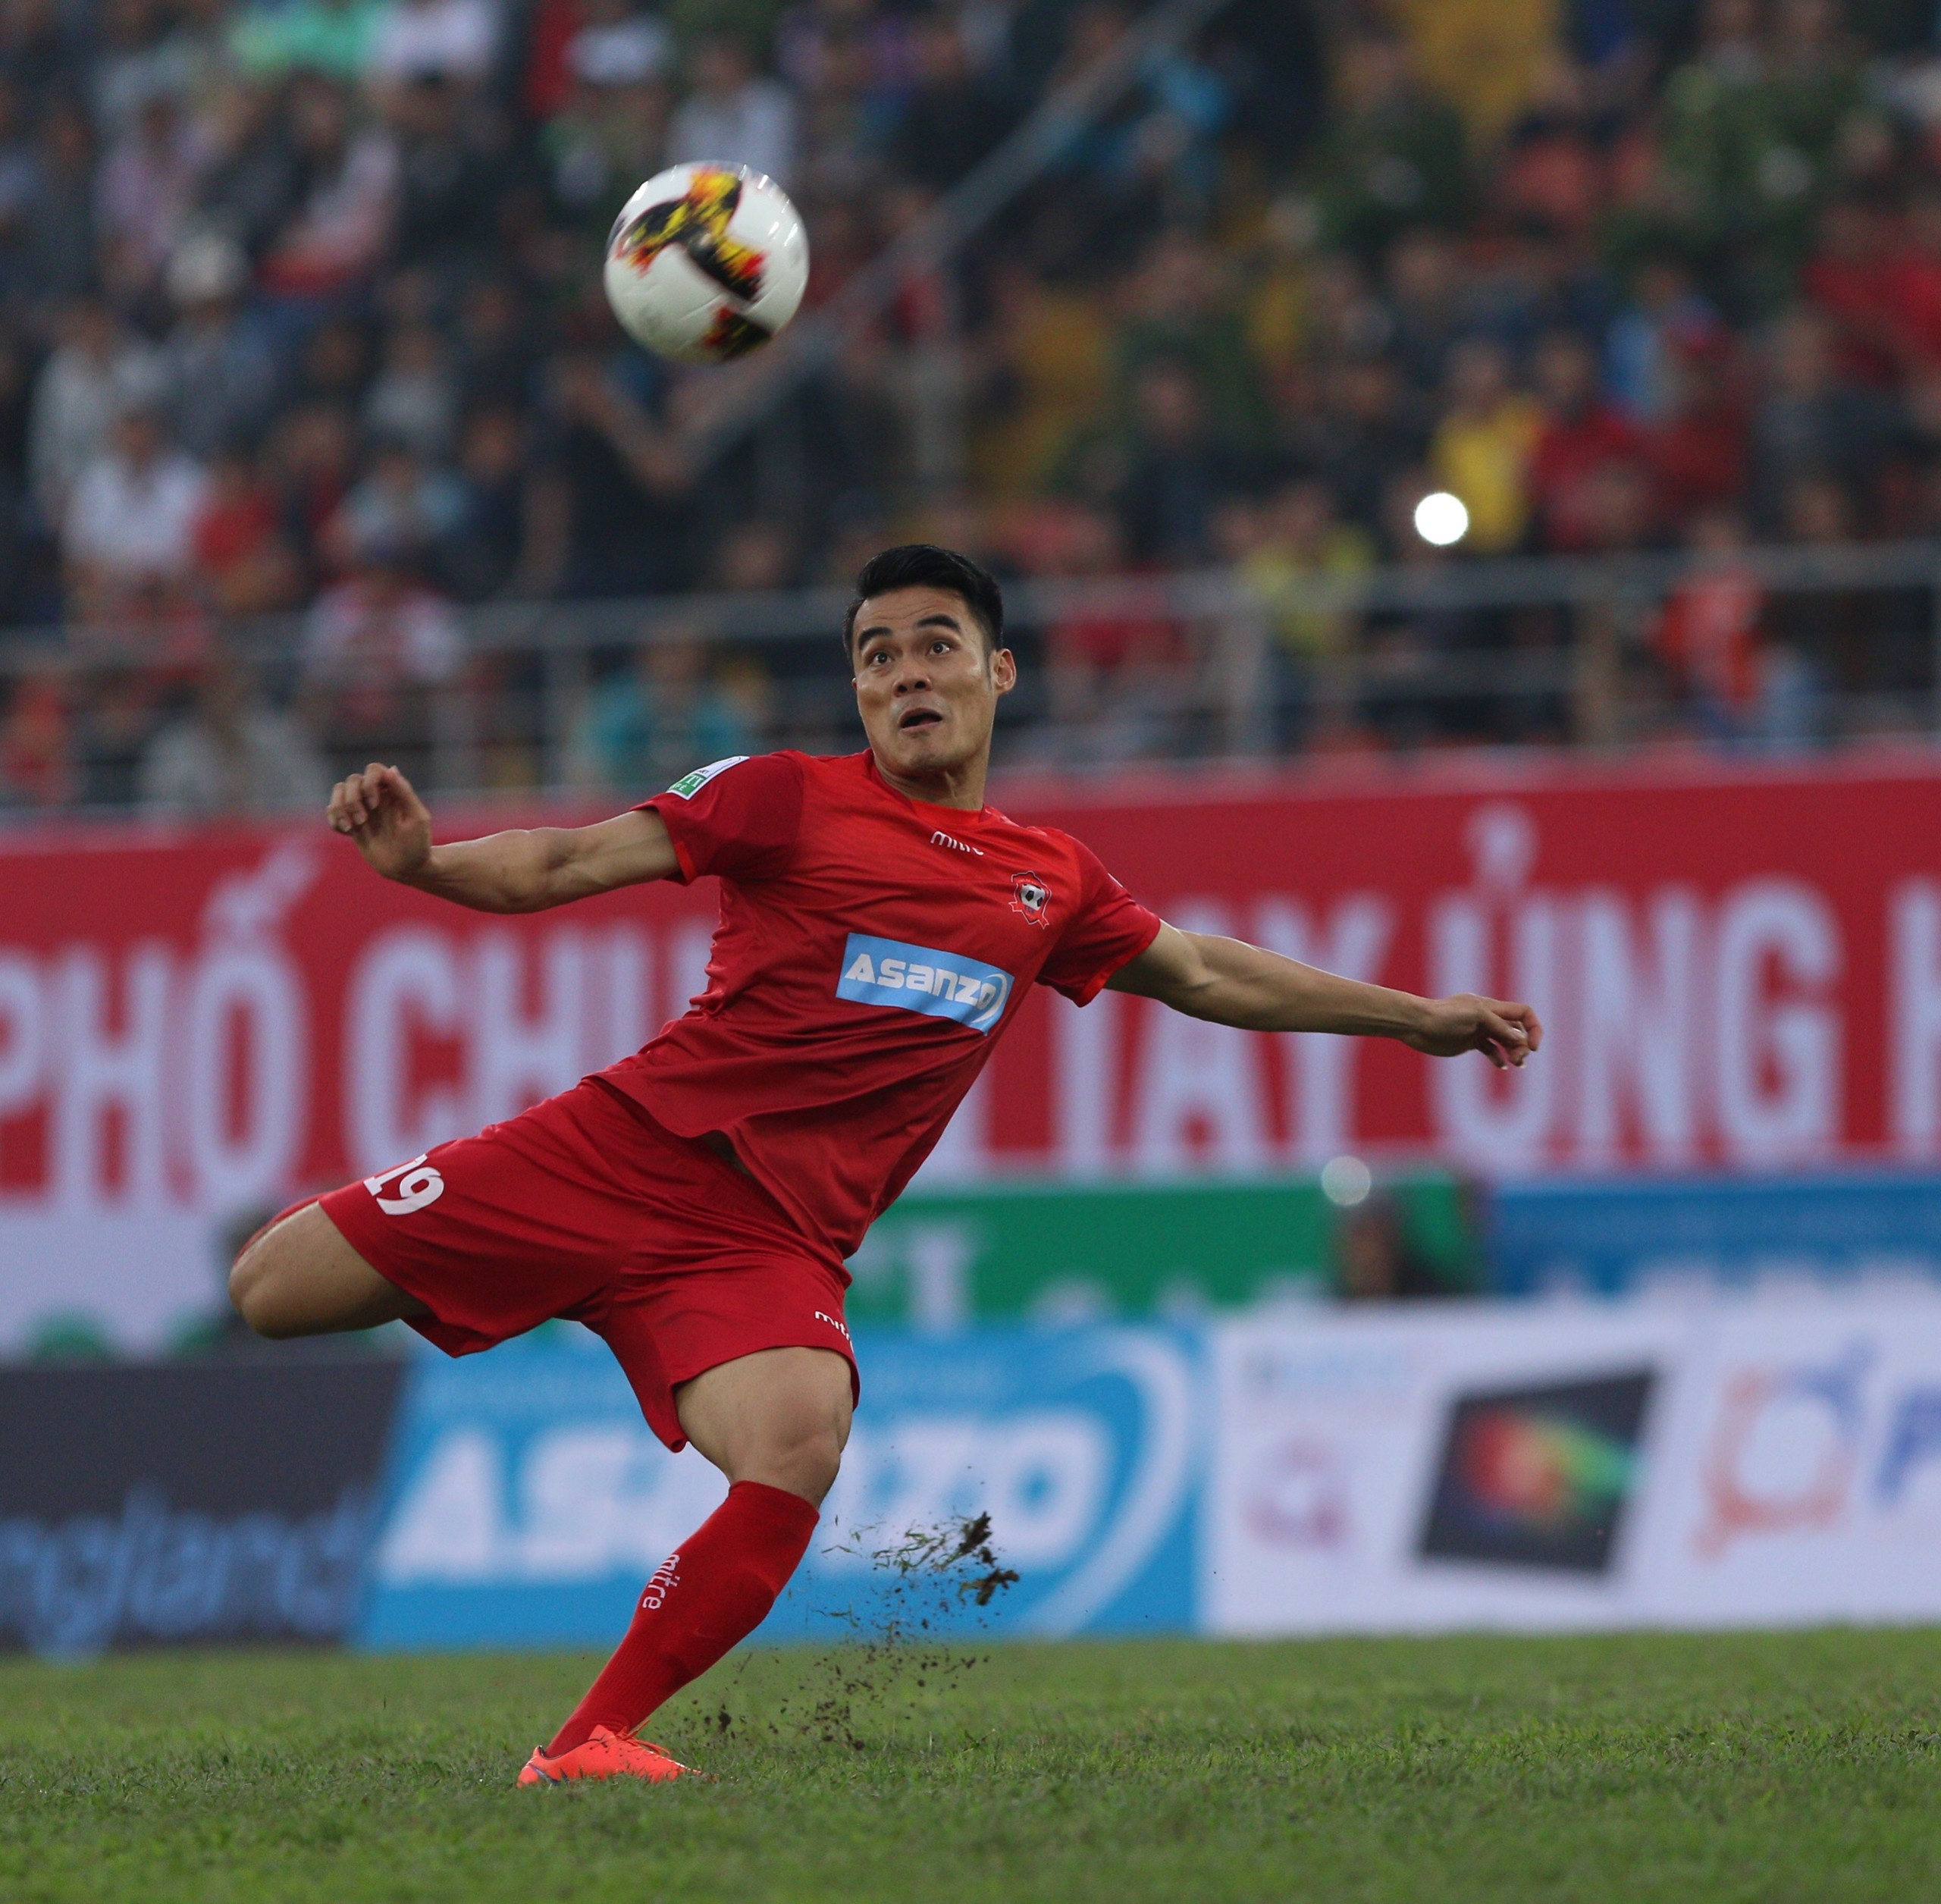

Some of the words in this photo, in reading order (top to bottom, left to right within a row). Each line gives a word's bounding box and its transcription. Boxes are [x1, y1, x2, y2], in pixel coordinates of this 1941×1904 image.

[1425, 802, 1841, 1175] ỦNG
[363, 1153, 445, 1215] 19
[641, 1554, 681, 1610] mitre
